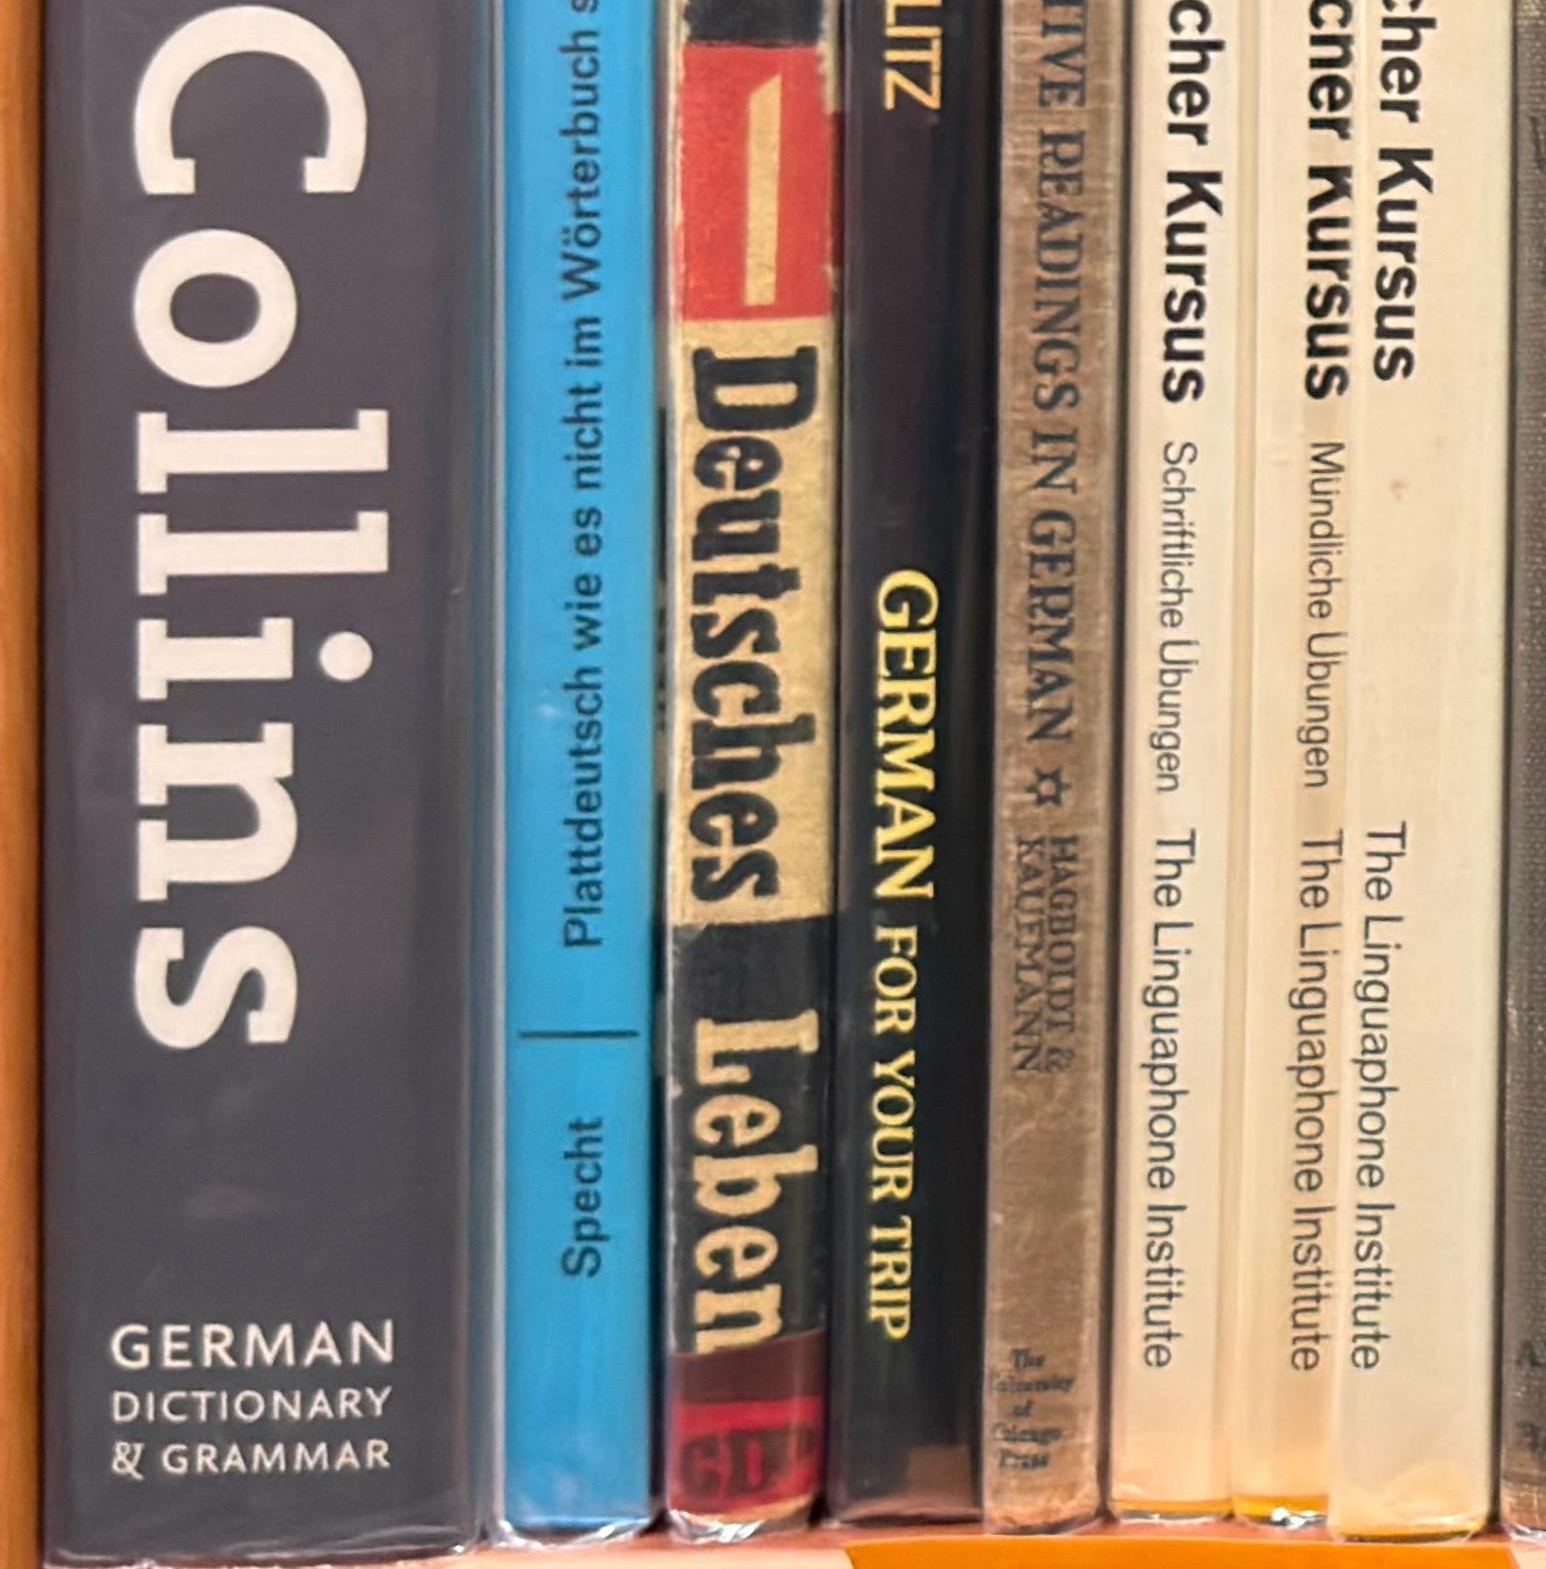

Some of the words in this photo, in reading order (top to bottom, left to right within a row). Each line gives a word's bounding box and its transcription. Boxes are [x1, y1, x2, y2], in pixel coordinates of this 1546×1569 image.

[558, 30, 602, 304] Wörterbuch
[565, 318, 602, 376] im
[1032, 128, 1086, 412] READINGS
[1162, 171, 1224, 404] Kursus
[1304, 165, 1353, 400] Kursus
[1372, 147, 1434, 381] Kursus
[563, 388, 604, 491] nicht
[1029, 431, 1081, 496] IN
[133, 4, 389, 1051] Collins
[576, 507, 604, 557] es
[1158, 439, 1199, 629] Schriftliche
[565, 575, 604, 659] wie
[692, 345, 819, 903] Deutsches
[1025, 510, 1077, 745] GERMAN
[564, 667, 604, 949] Plattdeutsch
[874, 569, 939, 900] GERMAN
[1153, 828, 1197, 911] The
[1300, 828, 1344, 911] The
[1364, 820, 1408, 903] The
[873, 924, 920, 1034] FOR
[1140, 921, 1194, 1191] Linguaphone
[1285, 921, 1343, 1194] Linguaphone
[1350, 915, 1405, 1189] Linguaphone
[563, 1116, 604, 1278] Specht
[692, 1009, 820, 1356] Leben
[870, 1050, 917, 1202] YOUR
[109, 1319, 395, 1370] GERMAN
[867, 1215, 913, 1339] TRIP
[1143, 1204, 1188, 1370] Institute
[1290, 1204, 1338, 1373] Institute
[1351, 1202, 1396, 1371] Institute
[112, 1385, 393, 1425] DICTIONARY
[112, 1440, 145, 1480] &
[162, 1439, 391, 1476] GRAMMAR
